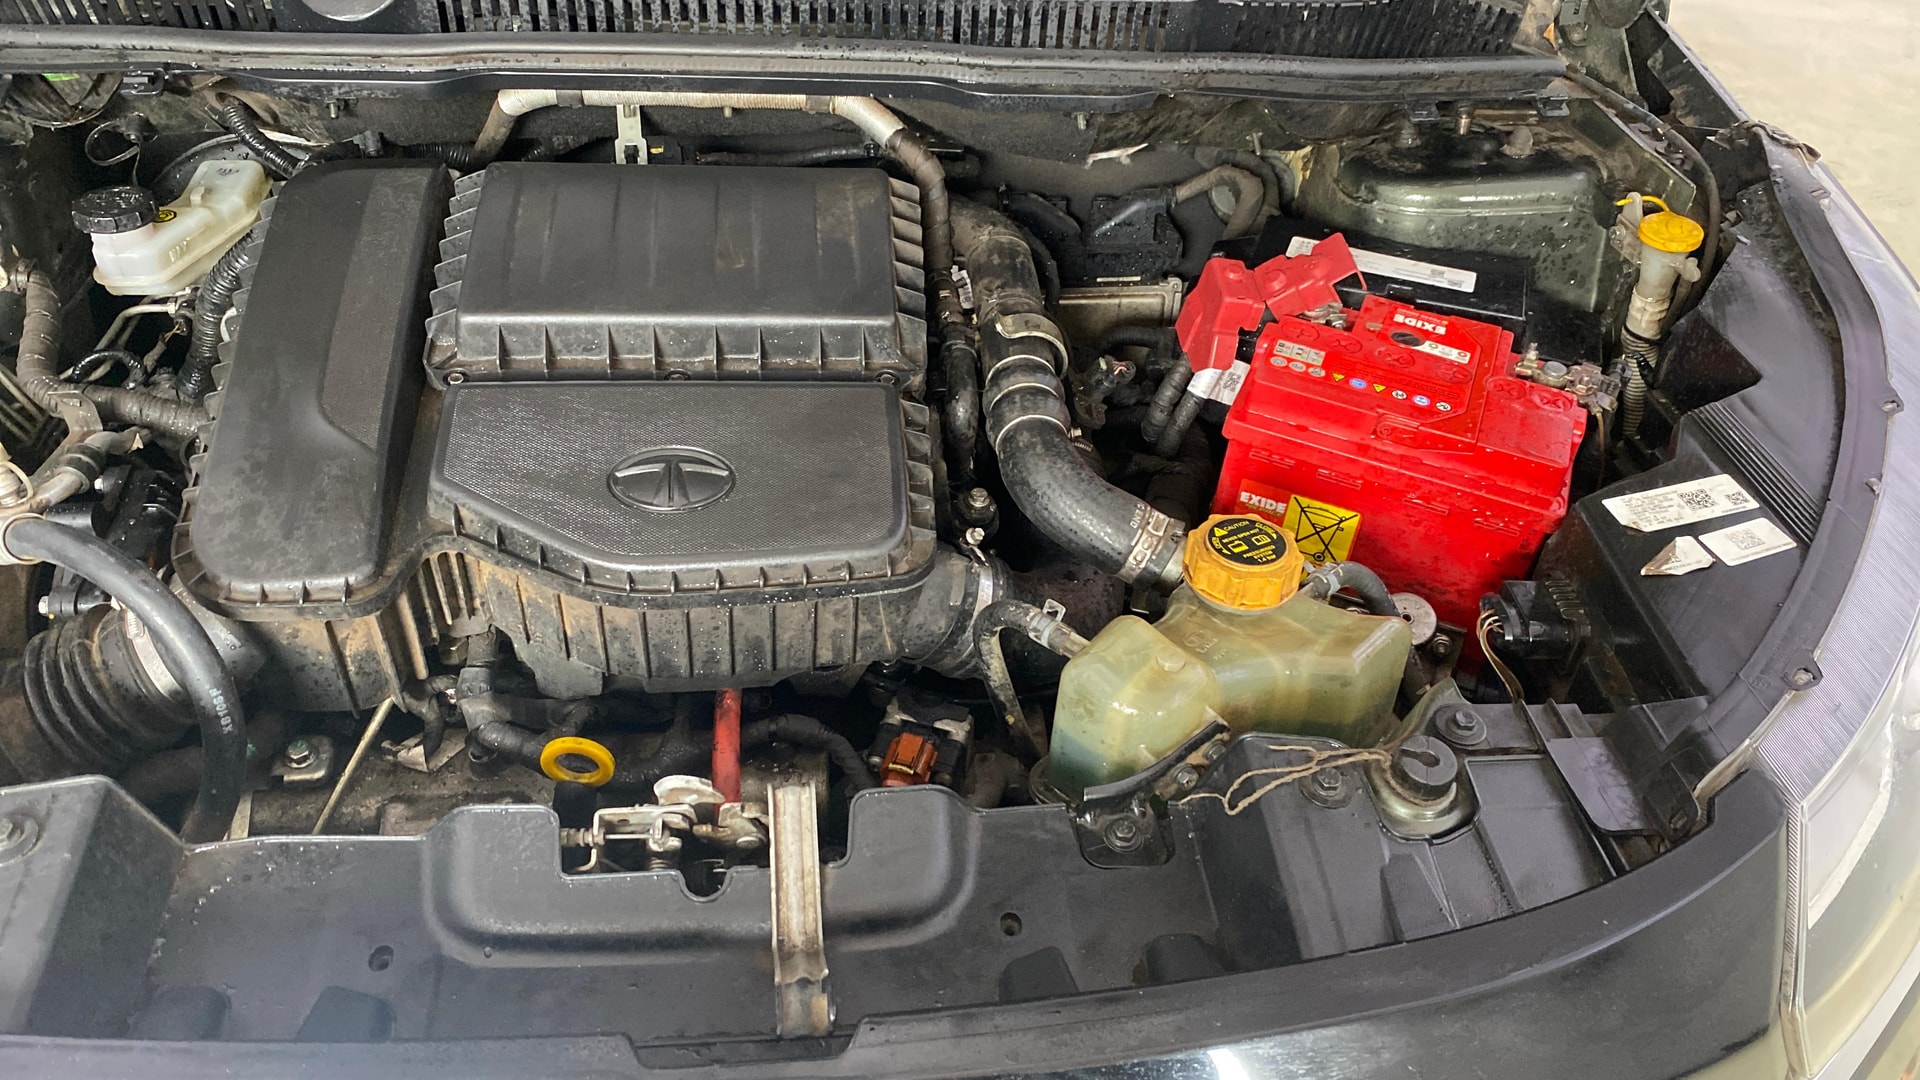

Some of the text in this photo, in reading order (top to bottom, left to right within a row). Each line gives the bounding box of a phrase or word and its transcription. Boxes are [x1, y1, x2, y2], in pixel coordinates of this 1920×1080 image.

[1393, 313, 1446, 335] EXIDE
[1240, 491, 1287, 514] EXIDE
[1130, 509, 1143, 529] END
[1223, 520, 1250, 531] CAUTION
